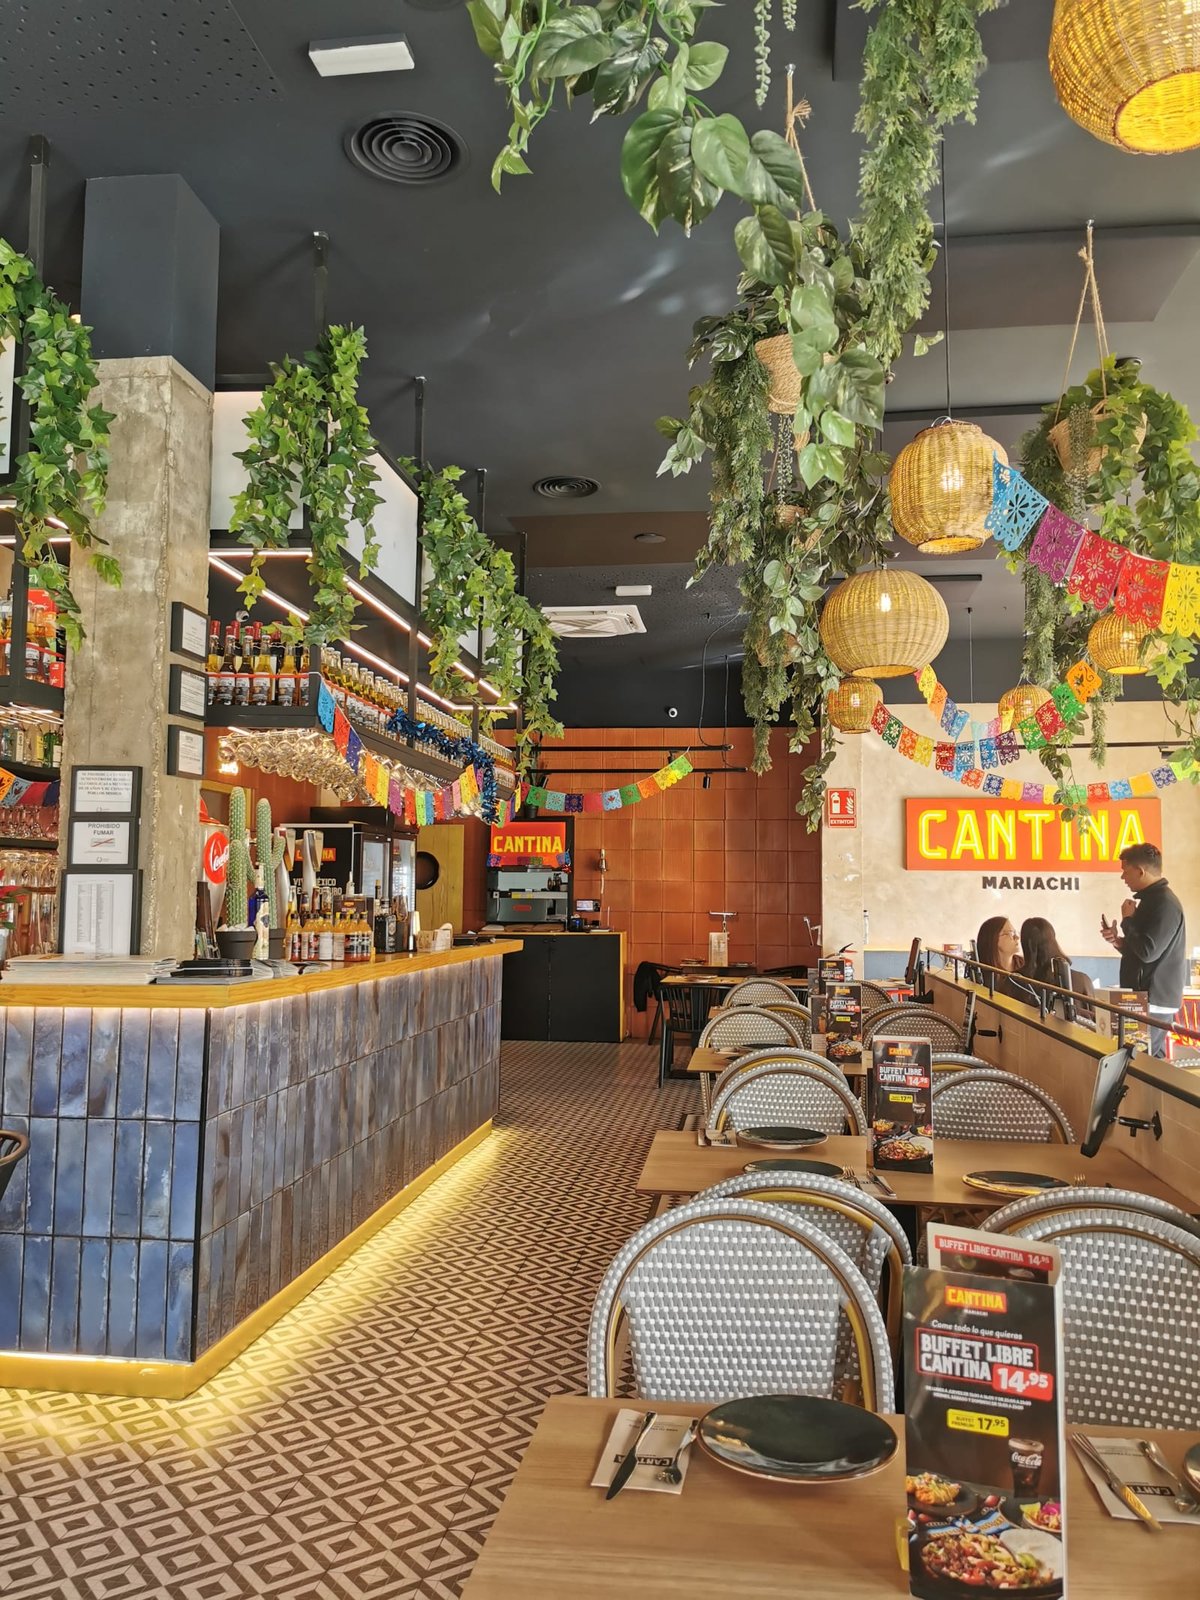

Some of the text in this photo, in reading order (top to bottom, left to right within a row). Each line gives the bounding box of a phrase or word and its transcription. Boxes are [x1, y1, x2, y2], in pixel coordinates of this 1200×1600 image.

[493, 835, 563, 853] CANTINA
[919, 809, 1147, 861] CANTINA
[982, 876, 1080, 891] MARIACHI
[880, 1066, 922, 1076] BUFFET LIBRE
[880, 1074, 907, 1083] CANTINA
[939, 1238, 969, 1251] BUFFET
[969, 1243, 991, 1256] LIBRE
[990, 1248, 1024, 1262] CANTINA
[946, 1288, 1004, 1309] CANTINA
[931, 1319, 1023, 1340] Come todo lo que quieras
[920, 1333, 1034, 1367] BUFFET LIBRE
[921, 1352, 992, 1381] CANTINA
